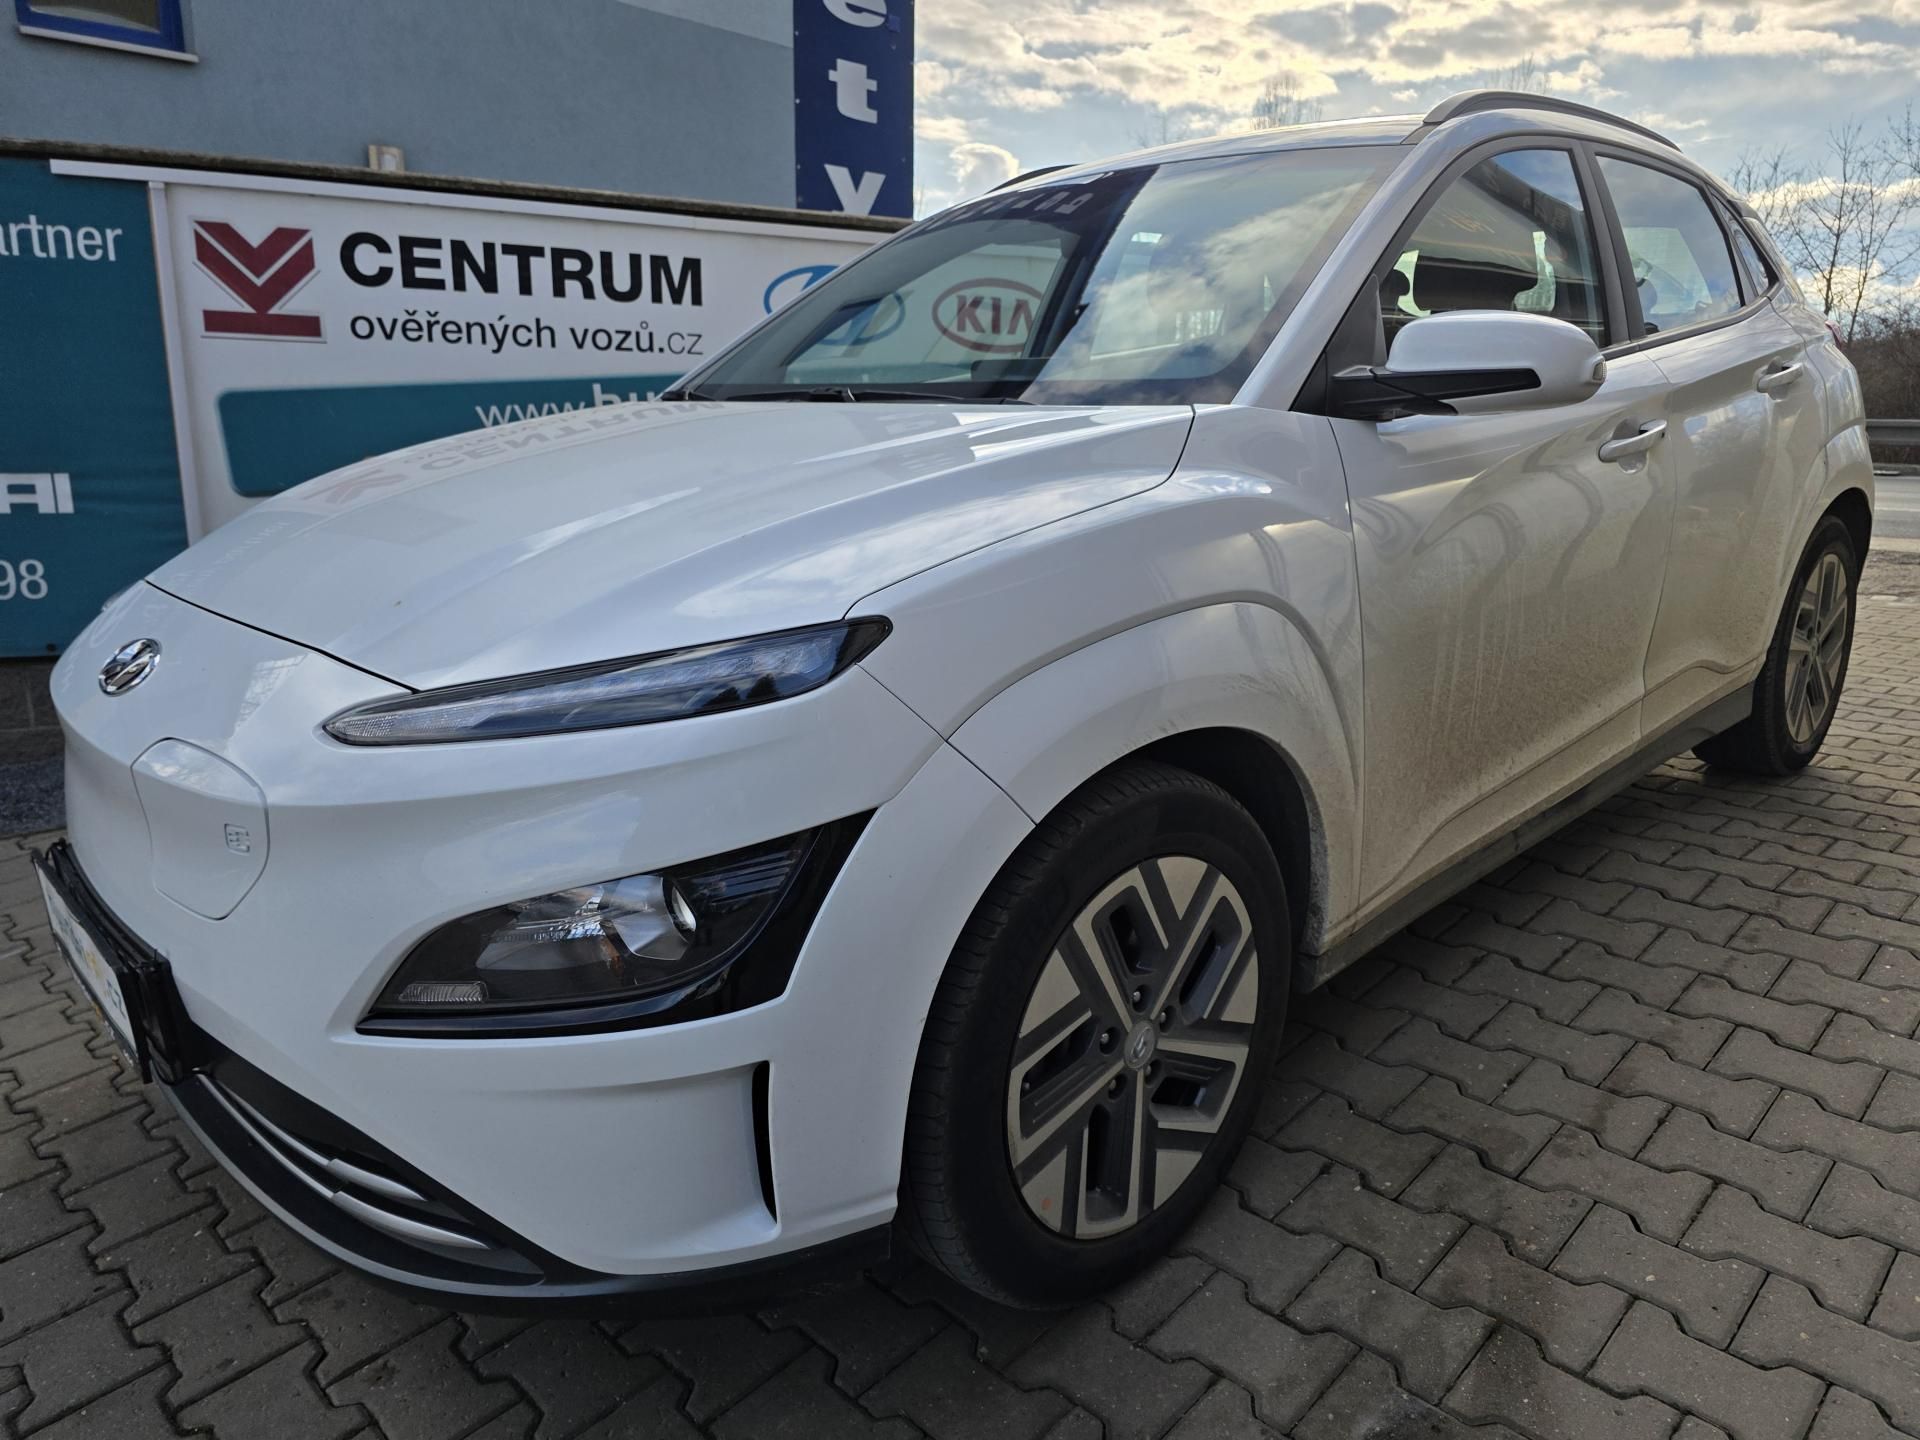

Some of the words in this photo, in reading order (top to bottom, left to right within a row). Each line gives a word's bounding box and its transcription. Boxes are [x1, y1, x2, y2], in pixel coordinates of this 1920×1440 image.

[340, 231, 703, 307] CENTRUM
[349, 309, 557, 354] ověřených
[569, 321, 703, 356] vozů.cz
[956, 294, 1034, 336] KIA
